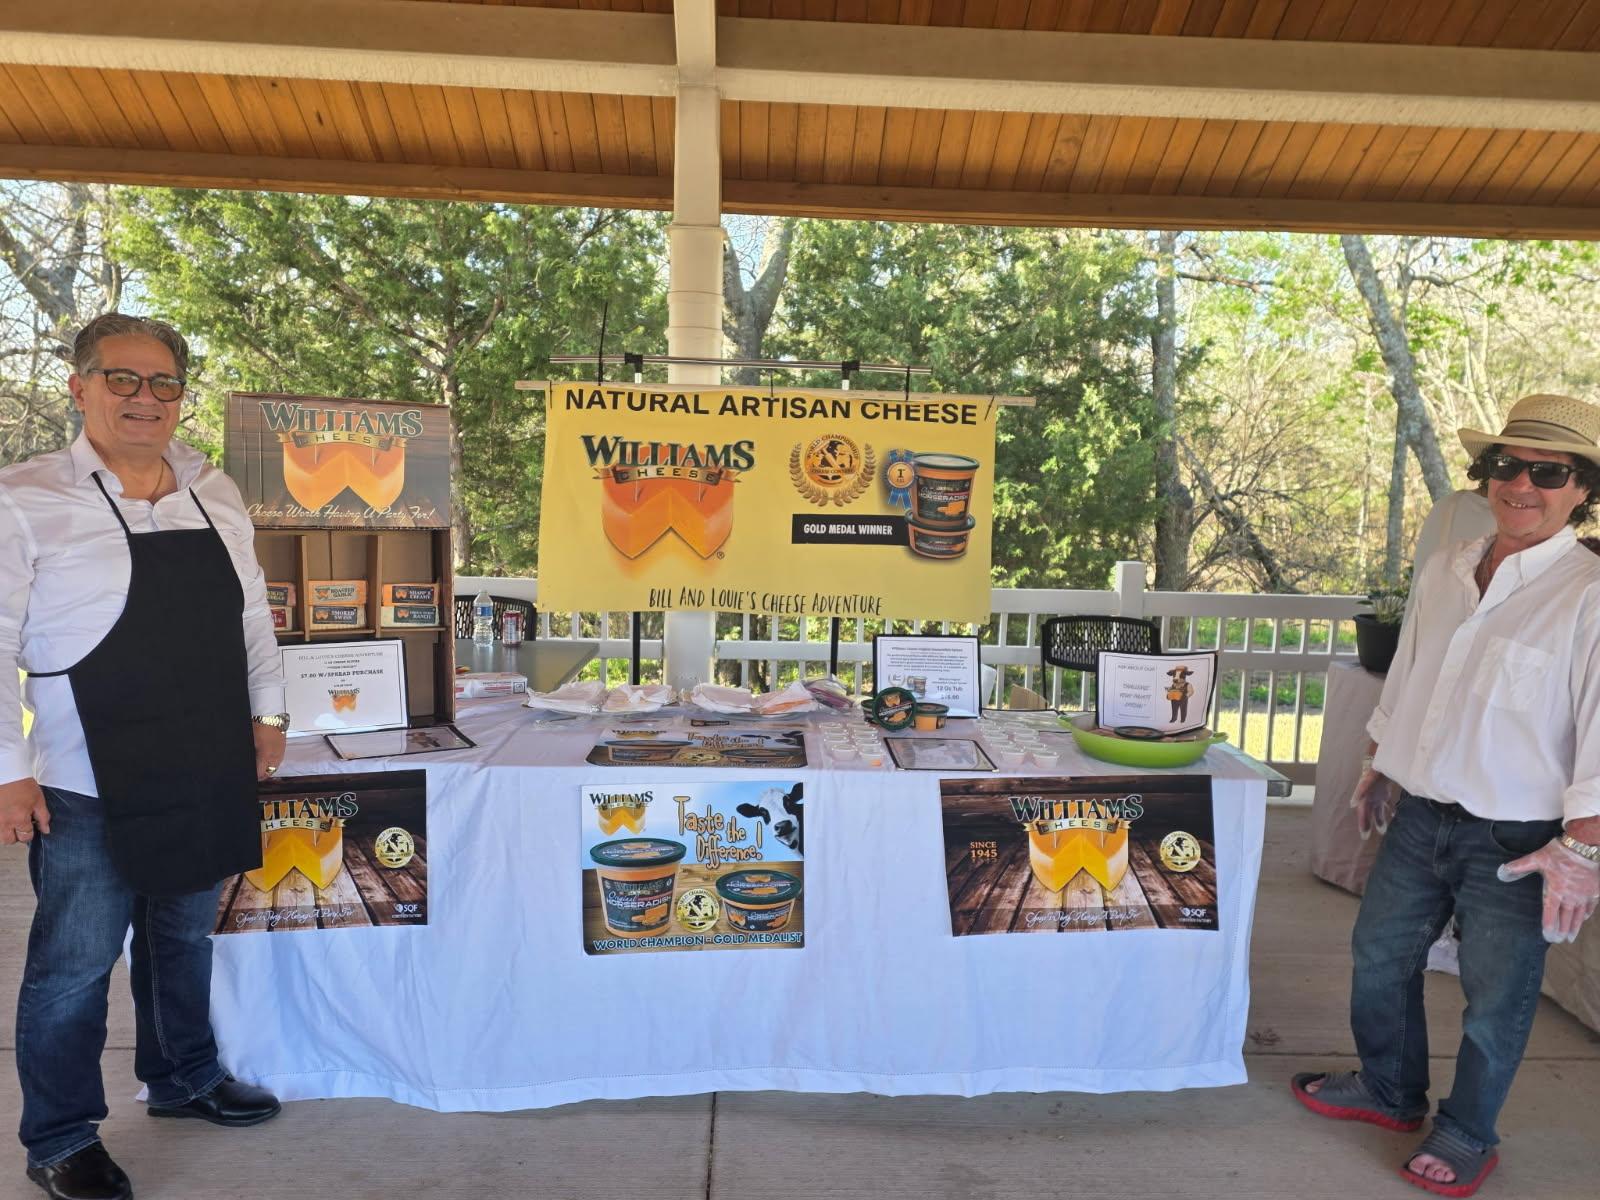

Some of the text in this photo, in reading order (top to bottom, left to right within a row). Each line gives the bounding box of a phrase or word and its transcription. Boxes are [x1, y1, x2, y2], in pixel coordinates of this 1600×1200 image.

[566, 389, 977, 425] NATURAL ARTISAN CHEESE
[259, 401, 424, 438] WILLIAMS
[580, 434, 755, 472] WILLIAMS
[620, 467, 715, 482] CHEESE
[286, 504, 321, 518] Worth
[321, 505, 362, 523] Having
[378, 505, 407, 523] Party
[803, 523, 893, 536] GOLD MEDAL WINNER
[649, 586, 883, 616] BILL AND LOUIE'S CHEESE ADVENTURE
[260, 792, 359, 820] LLIAMS
[589, 790, 654, 805] WILLIAMS
[673, 795, 724, 836] Taste
[1009, 793, 1145, 822] WILLIAMS
[265, 820, 329, 830] HEESE
[726, 815, 746, 843] the
[1041, 819, 1113, 834] CHEESE
[970, 841, 997, 849] SINCE
[970, 849, 998, 859] 1945
[404, 904, 418, 913] SQF
[606, 896, 672, 909] HORSERADISH
[593, 939, 638, 951] WORLD
[640, 935, 705, 948] CHAMPION
[713, 934, 747, 945] GOLD
[748, 932, 803, 944] MEDALIST
